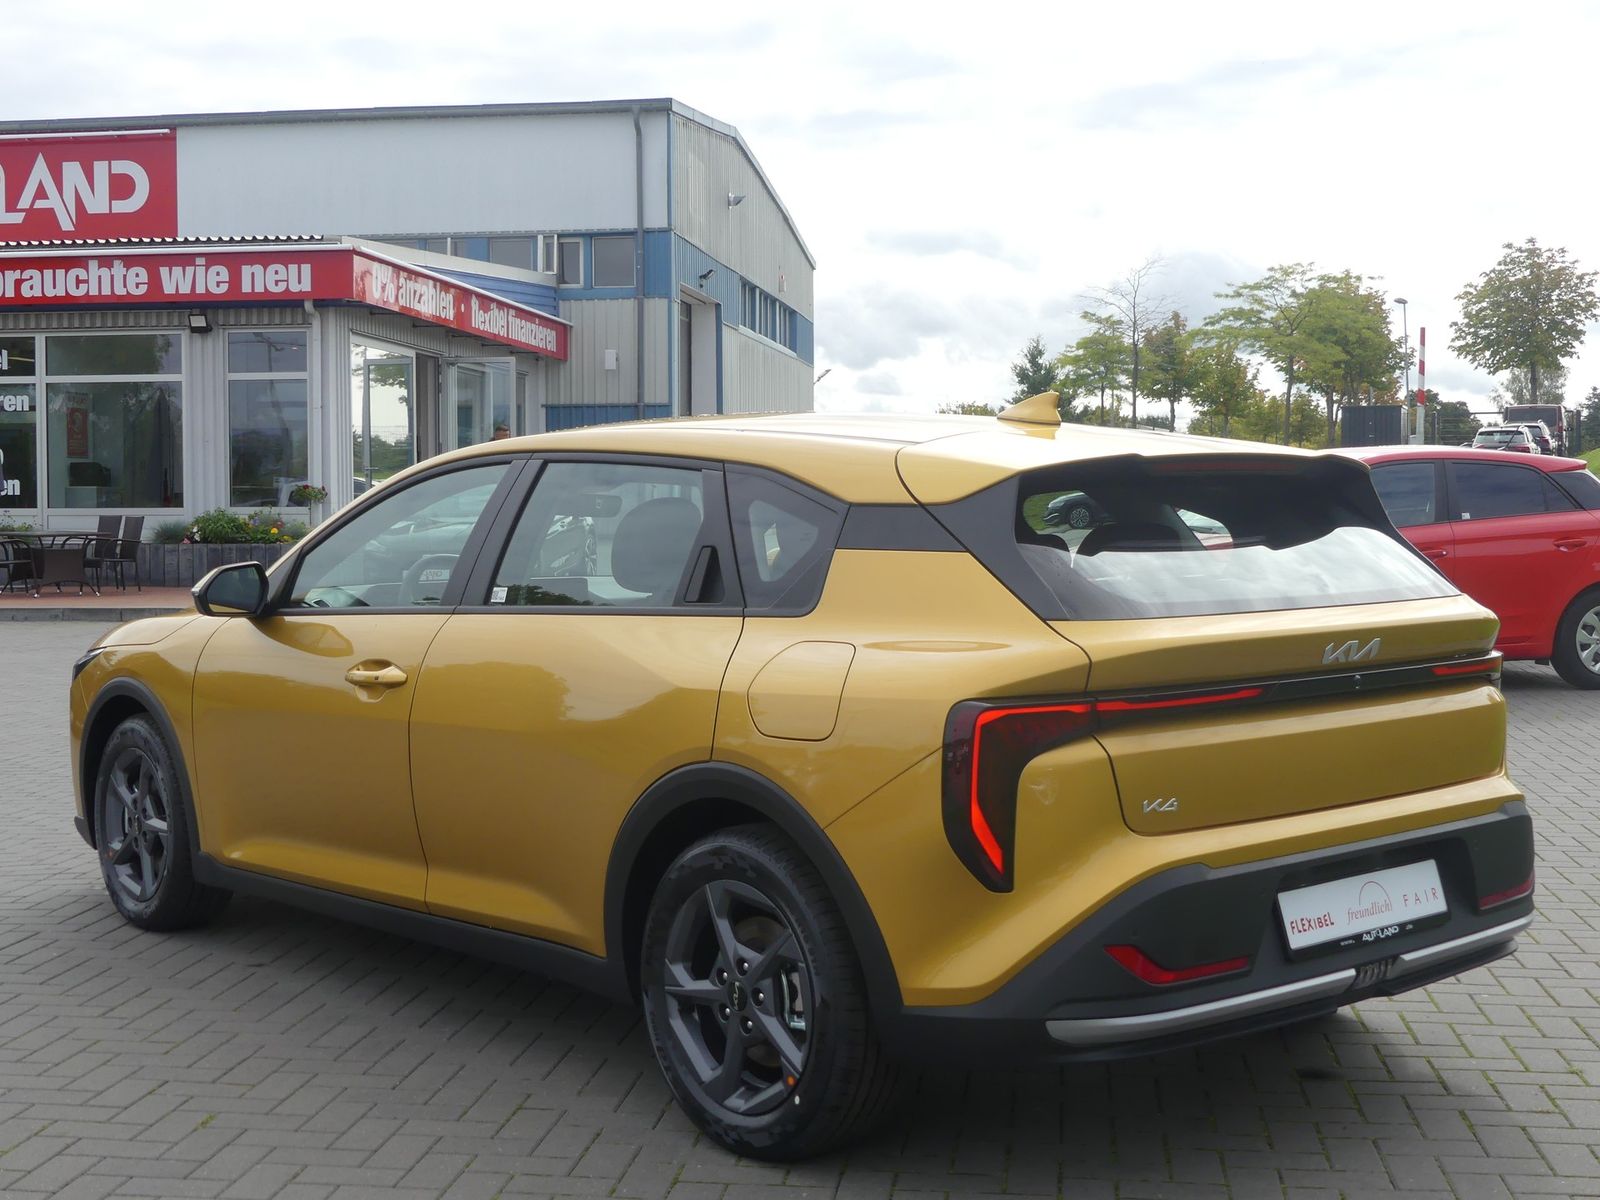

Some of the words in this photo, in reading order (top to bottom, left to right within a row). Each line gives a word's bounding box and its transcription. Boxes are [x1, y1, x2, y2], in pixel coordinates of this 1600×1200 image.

[159, 257, 229, 294] wie
[241, 264, 312, 293] neu
[372, 263, 395, 303] 0%
[398, 277, 455, 321] anzahlen
[471, 294, 508, 338] flexibel
[508, 309, 556, 352] finanzieren
[1322, 637, 1381, 664] KIA
[1143, 797, 1178, 814] K4
[1290, 911, 1335, 935] FLEXIBEL
[1347, 899, 1391, 925] freundlich
[1402, 887, 1439, 908] FAIR
[1362, 925, 1399, 942] AUTOLAND
